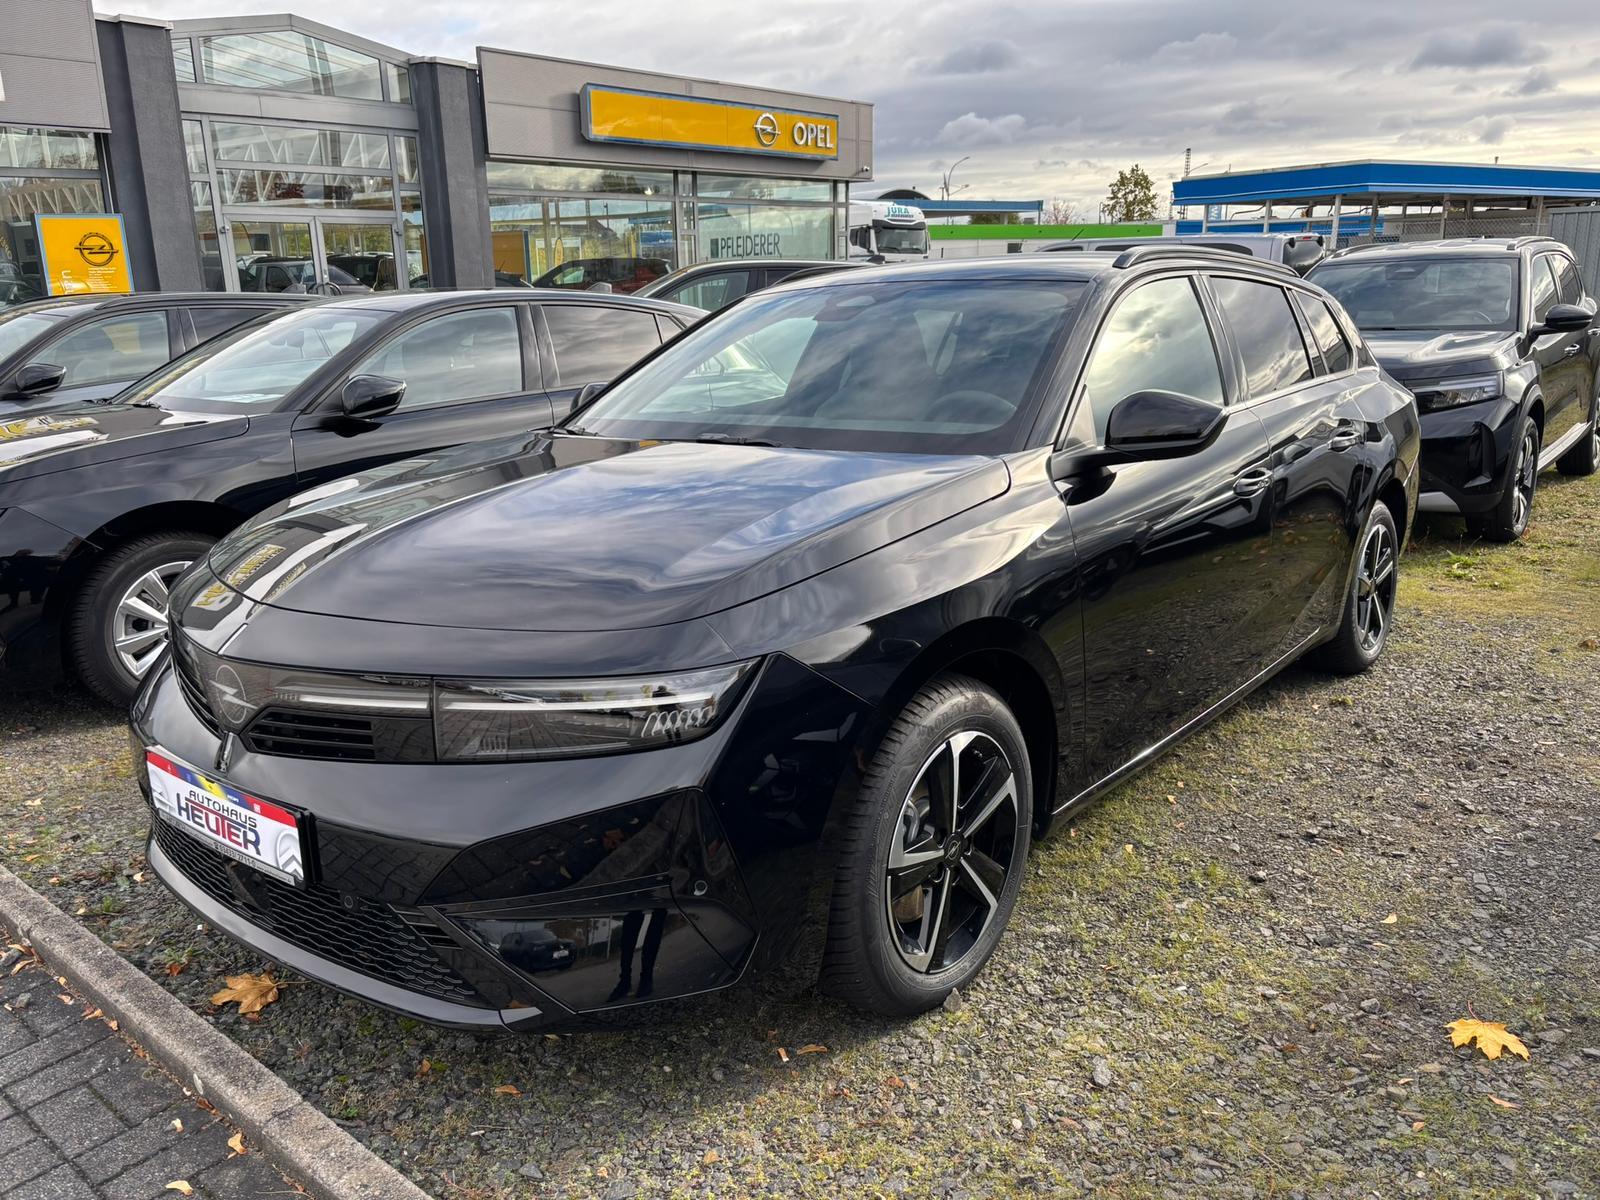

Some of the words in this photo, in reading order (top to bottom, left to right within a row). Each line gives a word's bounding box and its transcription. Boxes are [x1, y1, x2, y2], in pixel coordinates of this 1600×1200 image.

[793, 121, 834, 149] OPEL
[885, 206, 910, 218] JURA
[720, 232, 782, 259] PFLEIDERER
[189, 789, 258, 829] AUTOHAUS
[176, 792, 262, 857] HEUTER
